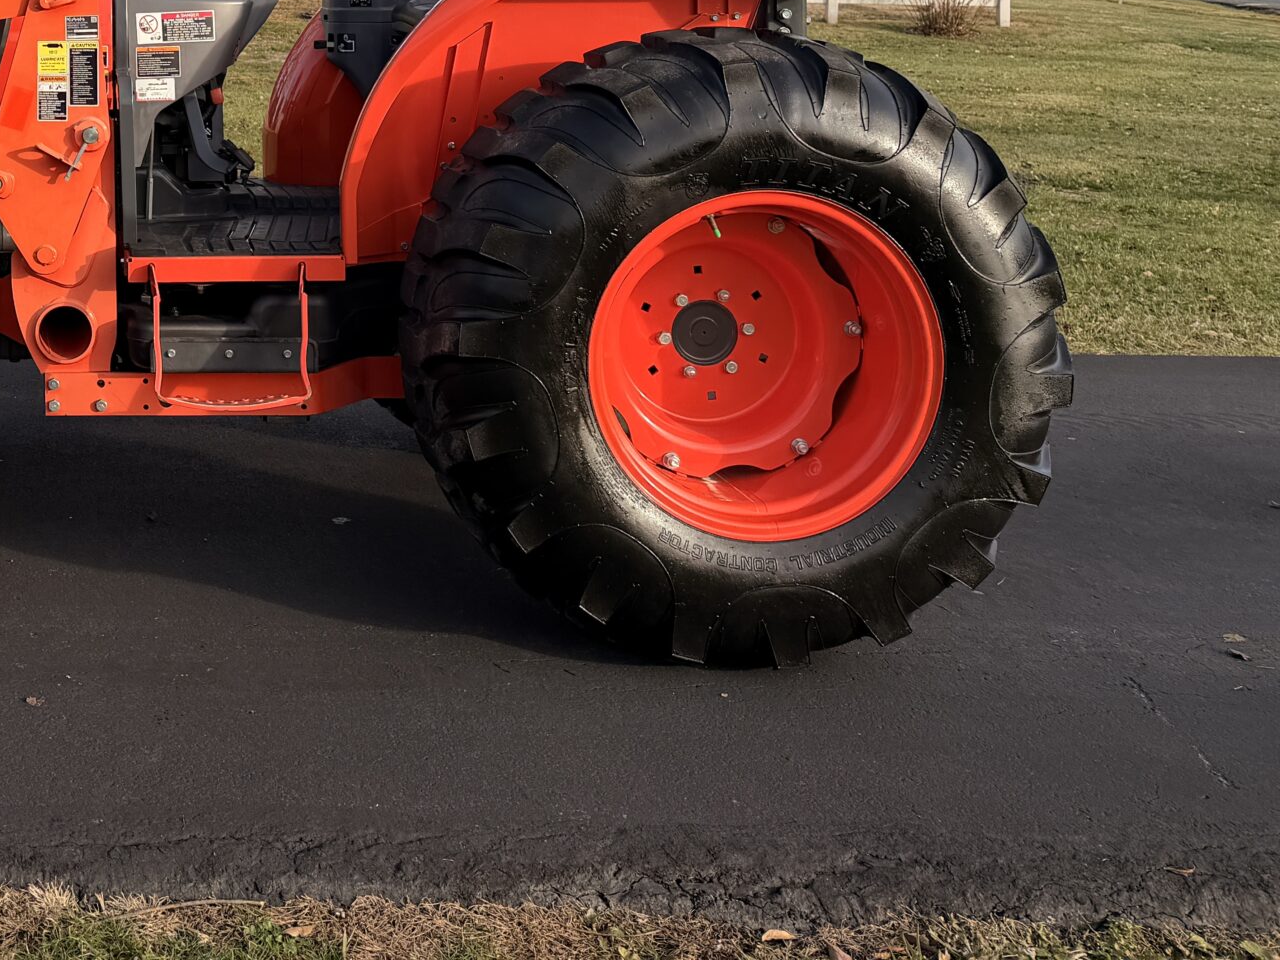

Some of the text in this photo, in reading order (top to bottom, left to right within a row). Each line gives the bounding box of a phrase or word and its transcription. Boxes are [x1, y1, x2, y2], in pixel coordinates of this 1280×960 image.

[741, 154, 910, 220] TITAN
[658, 514, 898, 572] INDUSTRIAL CONTRACTOR
